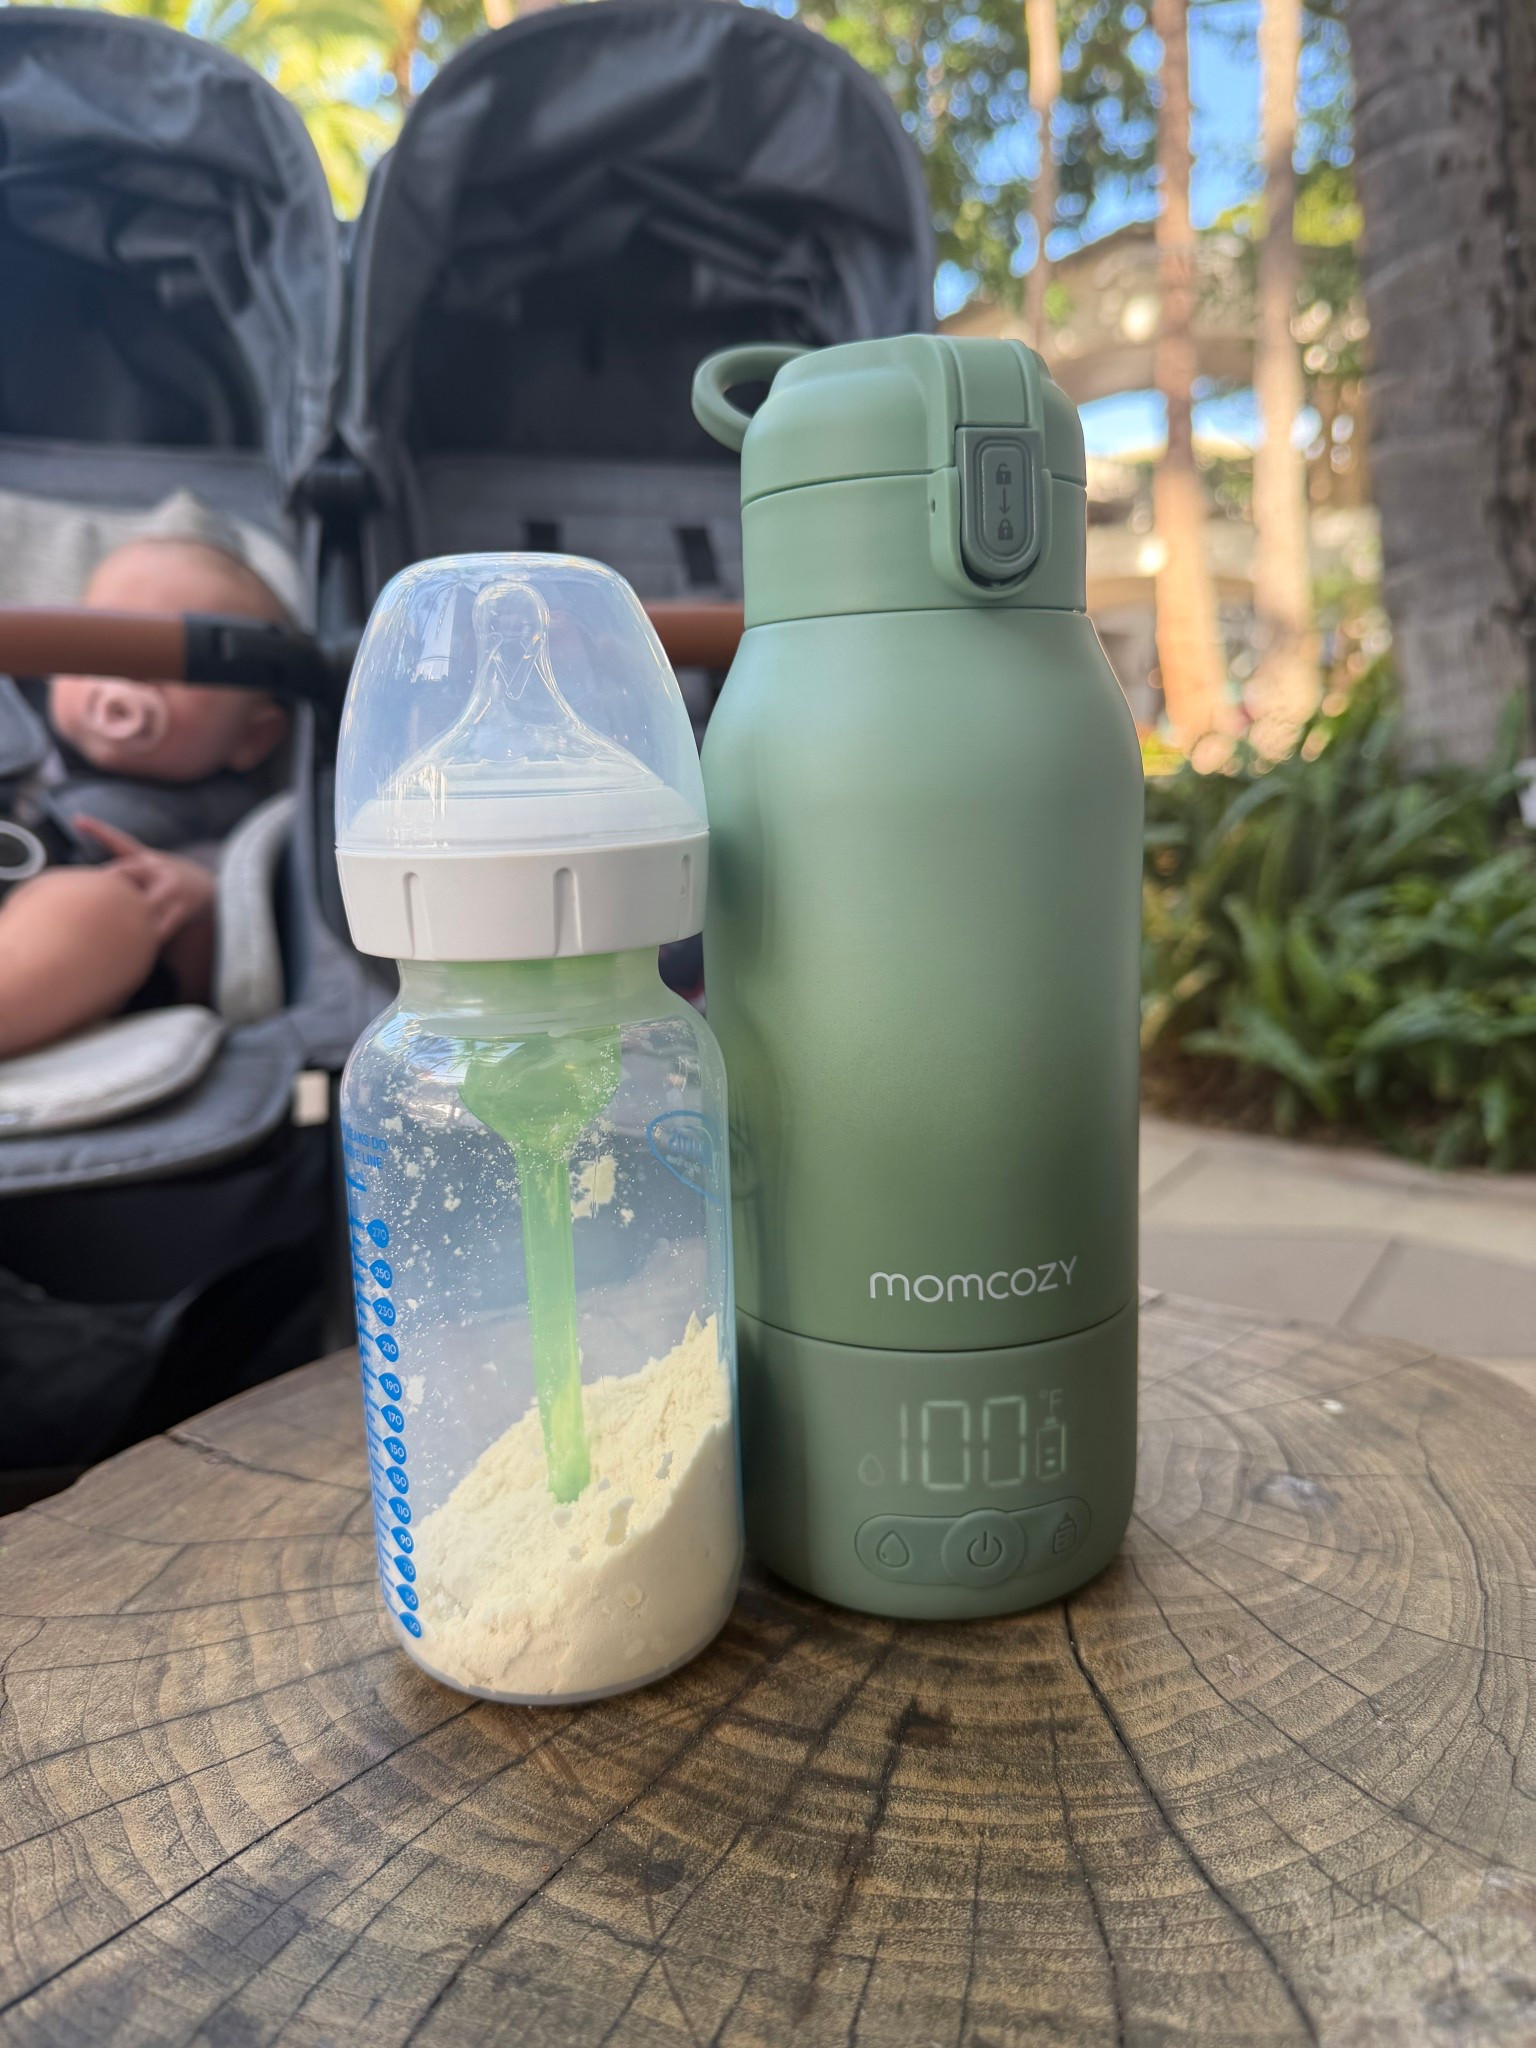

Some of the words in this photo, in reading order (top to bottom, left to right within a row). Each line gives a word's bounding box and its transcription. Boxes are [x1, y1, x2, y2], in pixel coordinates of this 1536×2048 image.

[371, 1136, 387, 1152] DO
[362, 1151, 383, 1169] LINE
[372, 1227, 387, 1241] 270
[374, 1266, 391, 1281] 250
[377, 1304, 394, 1319] 230
[382, 1340, 397, 1355] 210
[385, 1378, 400, 1394] 190
[387, 1410, 402, 1426] 170
[389, 1442, 405, 1458] 150
[900, 1395, 1027, 1491] 100
[392, 1471, 407, 1487] 130
[396, 1503, 410, 1518] 110
[400, 1534, 412, 1547] 90
[403, 1562, 414, 1576] 70
